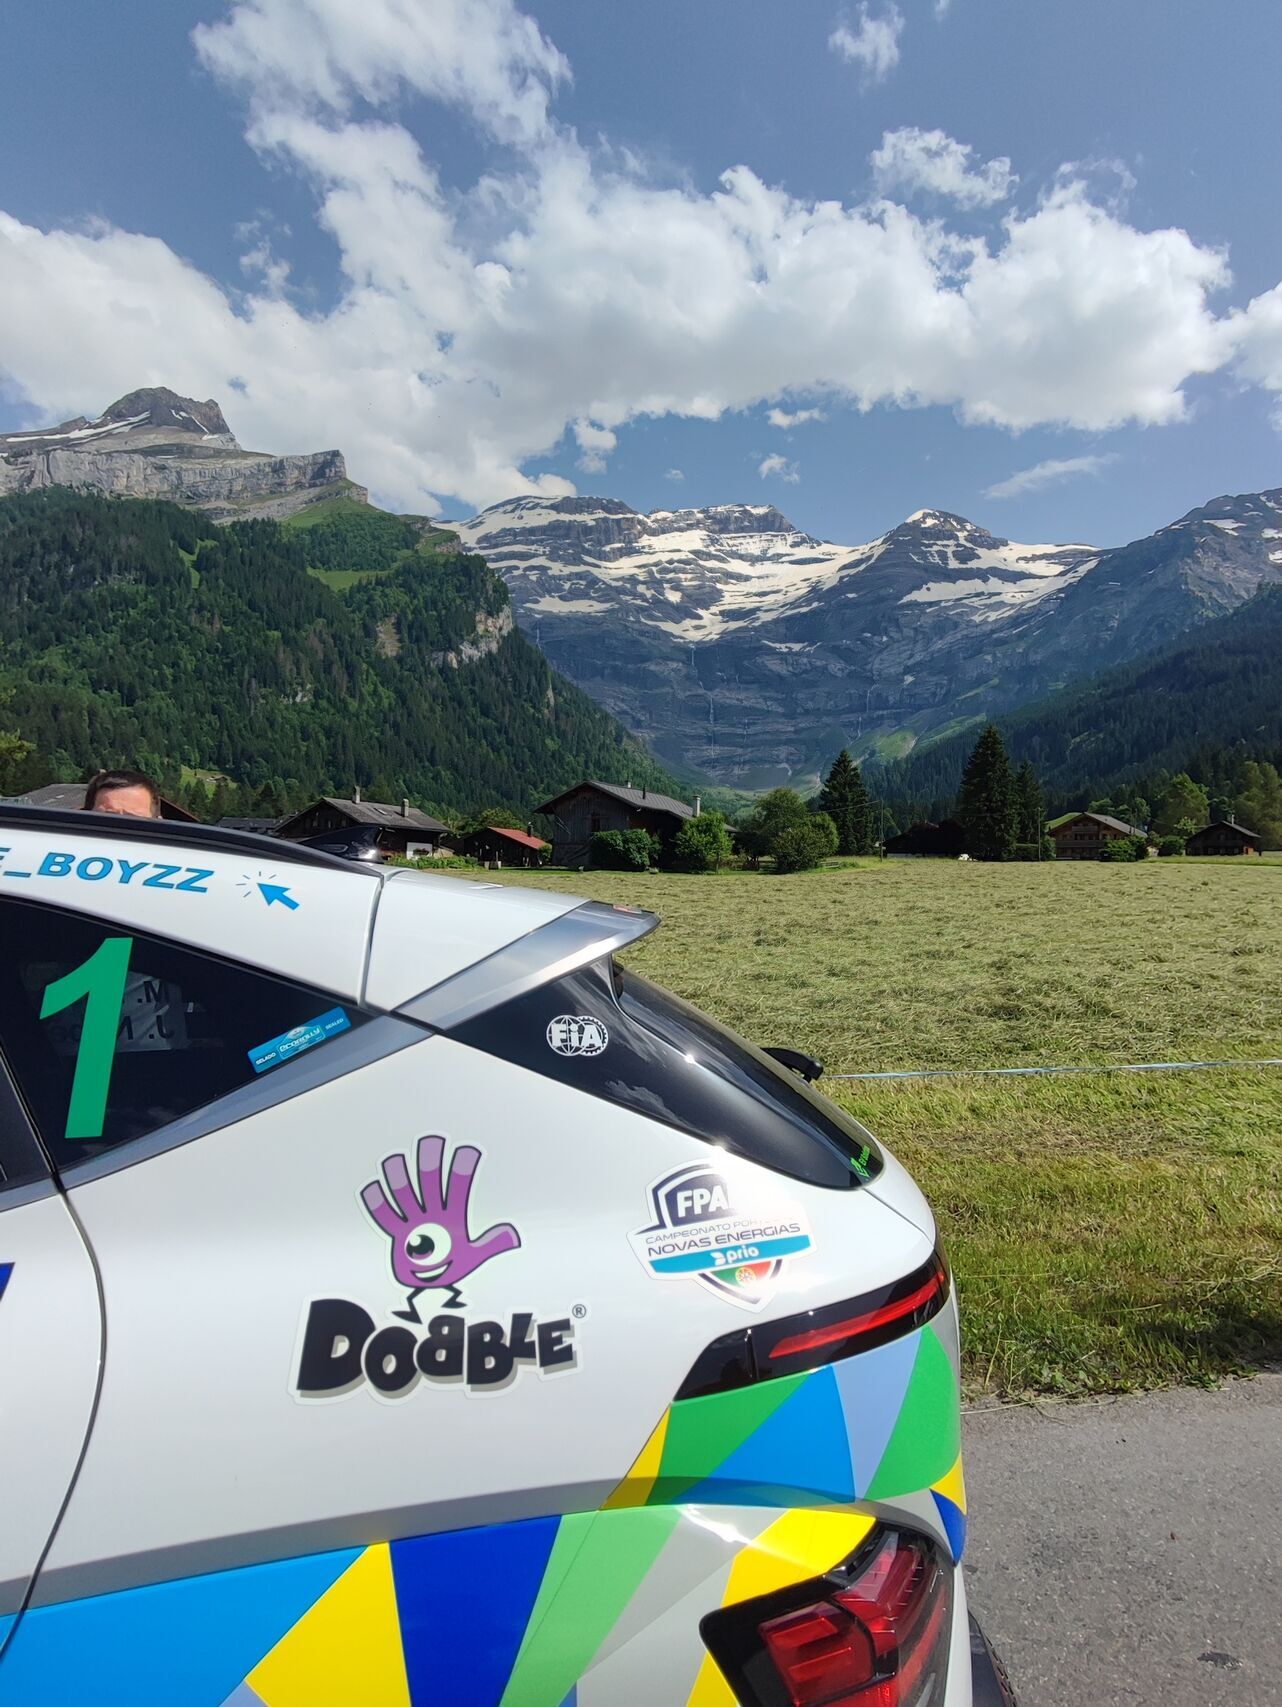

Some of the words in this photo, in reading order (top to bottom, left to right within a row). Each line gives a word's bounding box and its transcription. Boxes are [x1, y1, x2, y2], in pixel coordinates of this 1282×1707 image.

[39, 937, 133, 1138] 1
[676, 1185, 729, 1219] FPA
[645, 1223, 731, 1245] CAMPEONATO
[647, 1237, 712, 1257] NOVAS
[715, 1222, 801, 1245] ENERGIAS
[725, 1244, 760, 1264] prio
